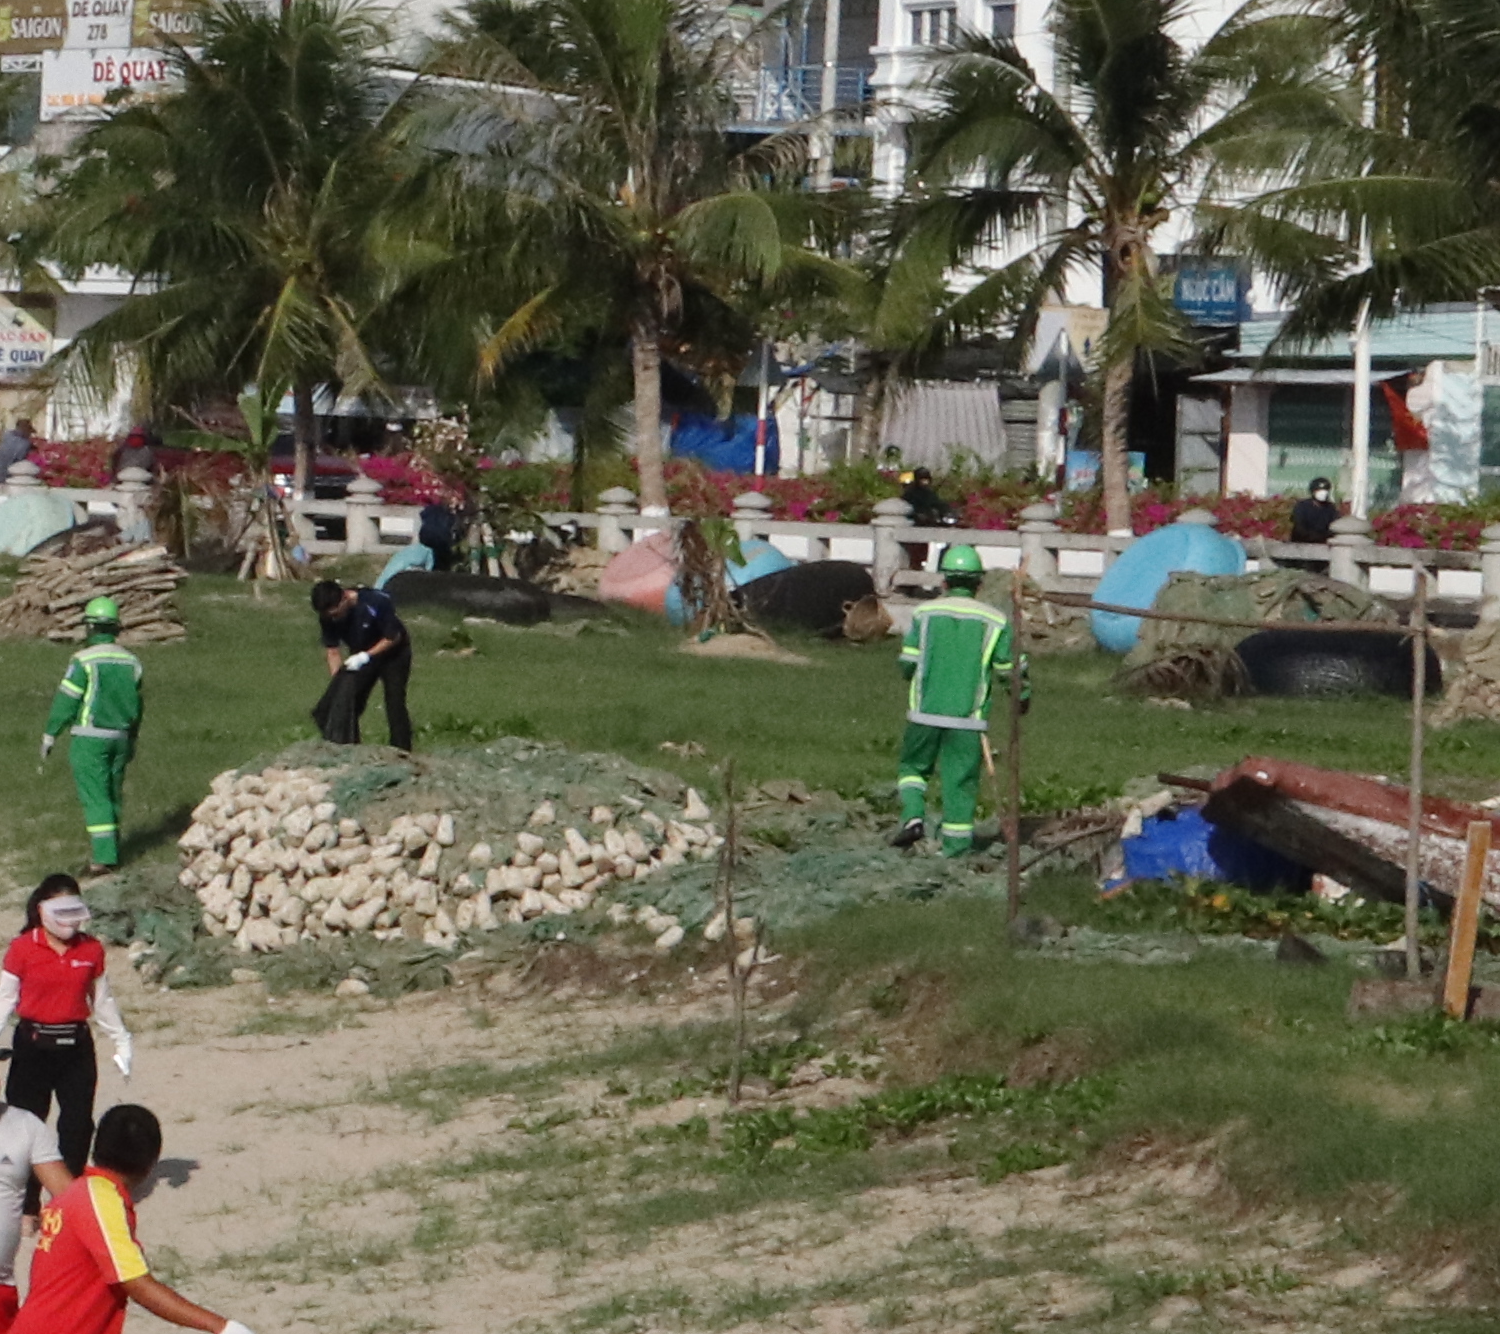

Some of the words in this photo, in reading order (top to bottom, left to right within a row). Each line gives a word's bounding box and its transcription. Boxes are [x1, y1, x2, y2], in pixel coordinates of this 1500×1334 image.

[92, 0, 130, 18] QUAY
[10, 16, 62, 39] SAIGON
[93, 56, 115, 83] DÊ
[119, 59, 168, 85] QUAY
[10, 349, 45, 364] QUAY
